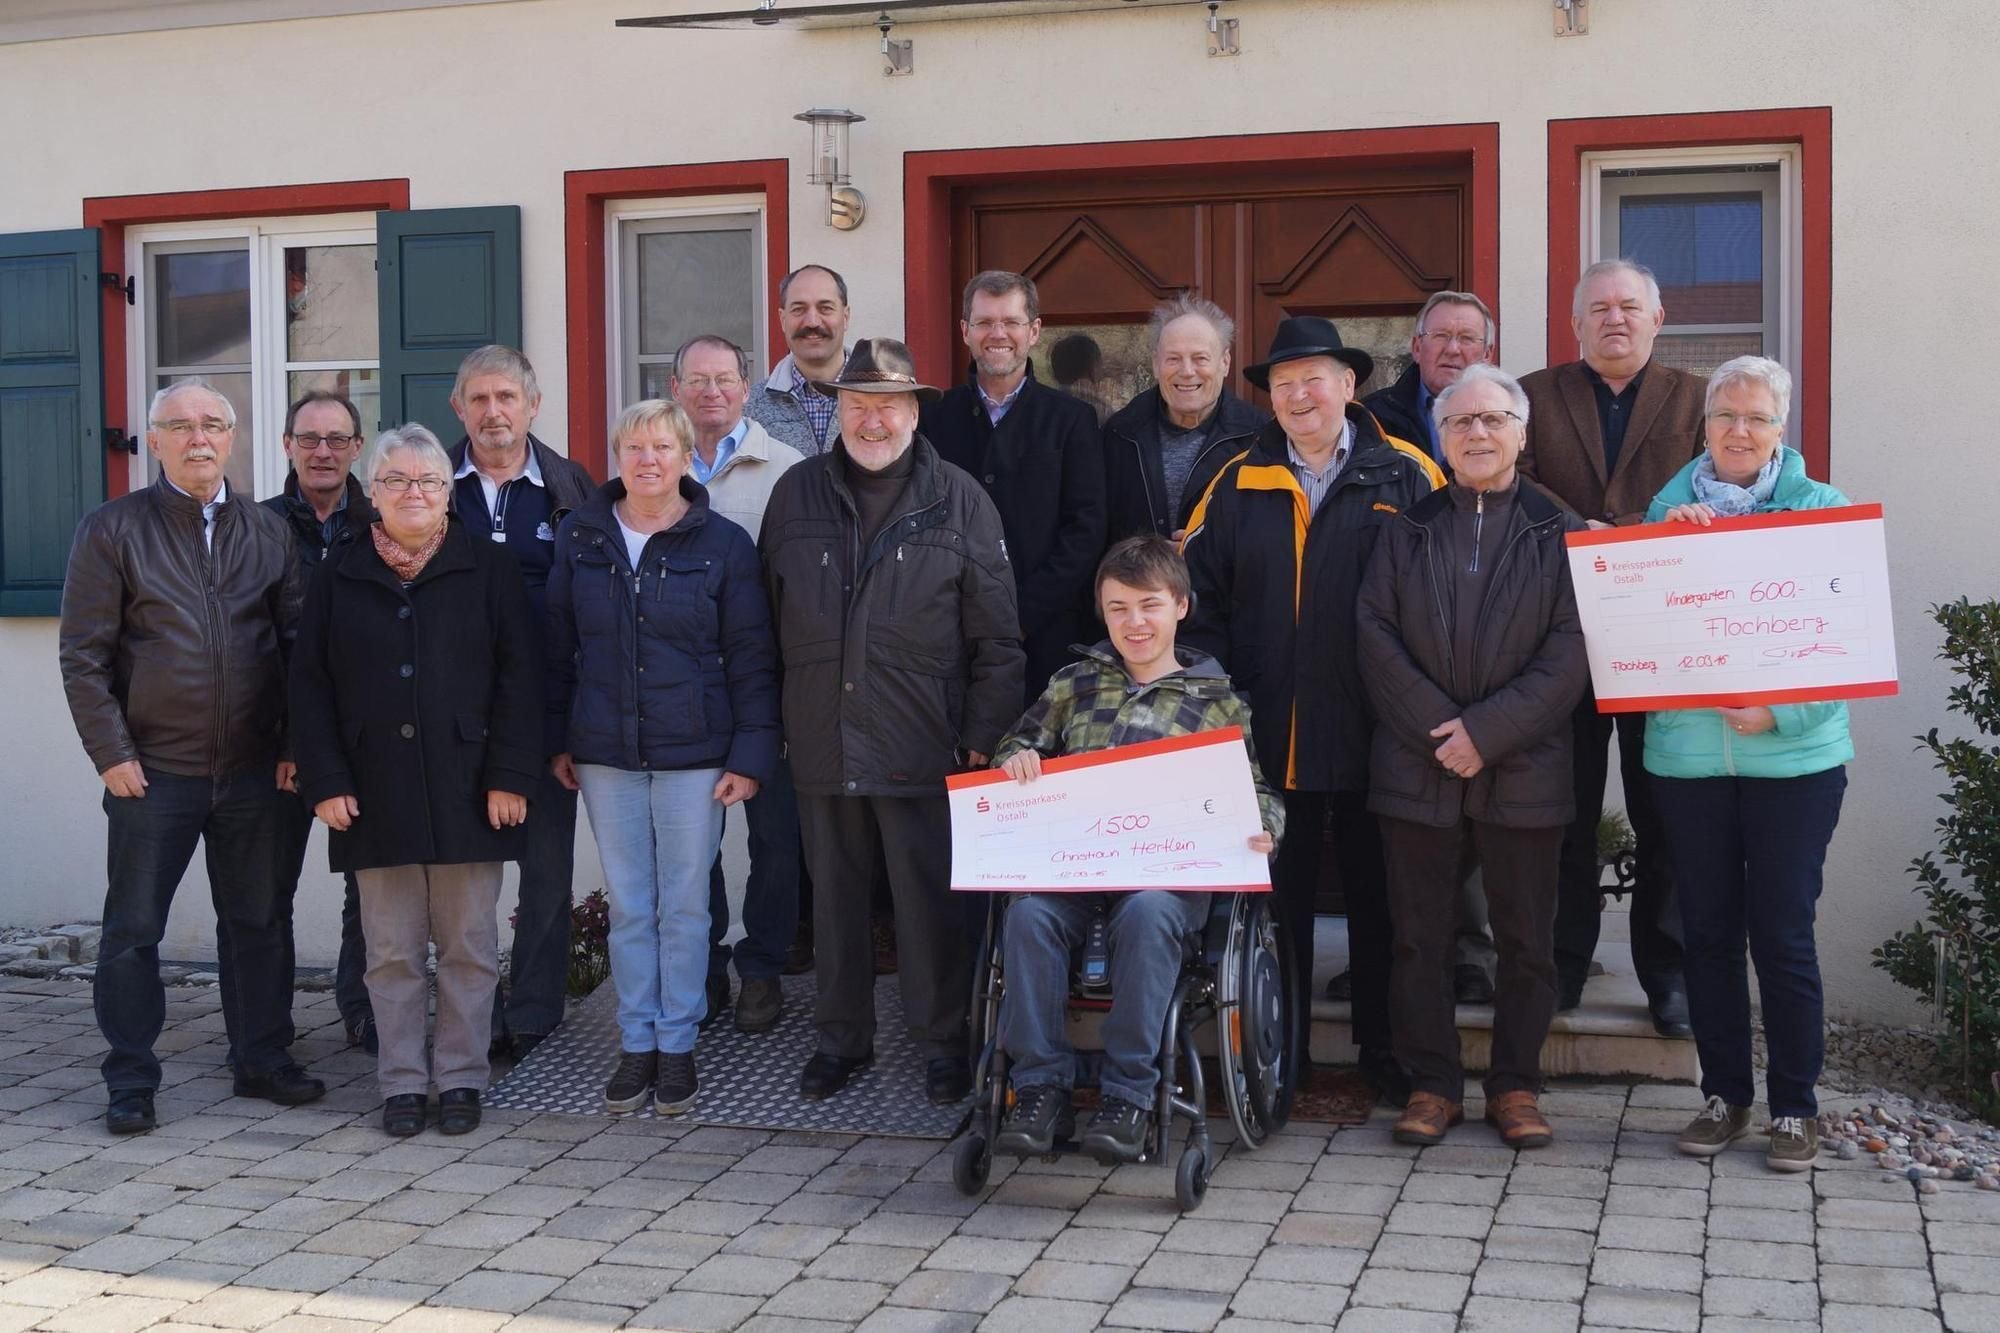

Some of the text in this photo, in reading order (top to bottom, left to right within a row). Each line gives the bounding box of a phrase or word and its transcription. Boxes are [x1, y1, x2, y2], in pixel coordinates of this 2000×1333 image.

[1612, 555, 1683, 571] Kreissparkasse
[1614, 573, 1644, 584] Ostalb
[1664, 588, 1735, 608] Kindergarten
[1829, 577, 1841, 593] €
[1704, 615, 1829, 638] Flochberg
[995, 790, 1068, 811] Kreissparkasse
[1203, 798, 1215, 815] €
[996, 810, 1029, 824] Ostalb
[1051, 849, 1120, 863] Christian
